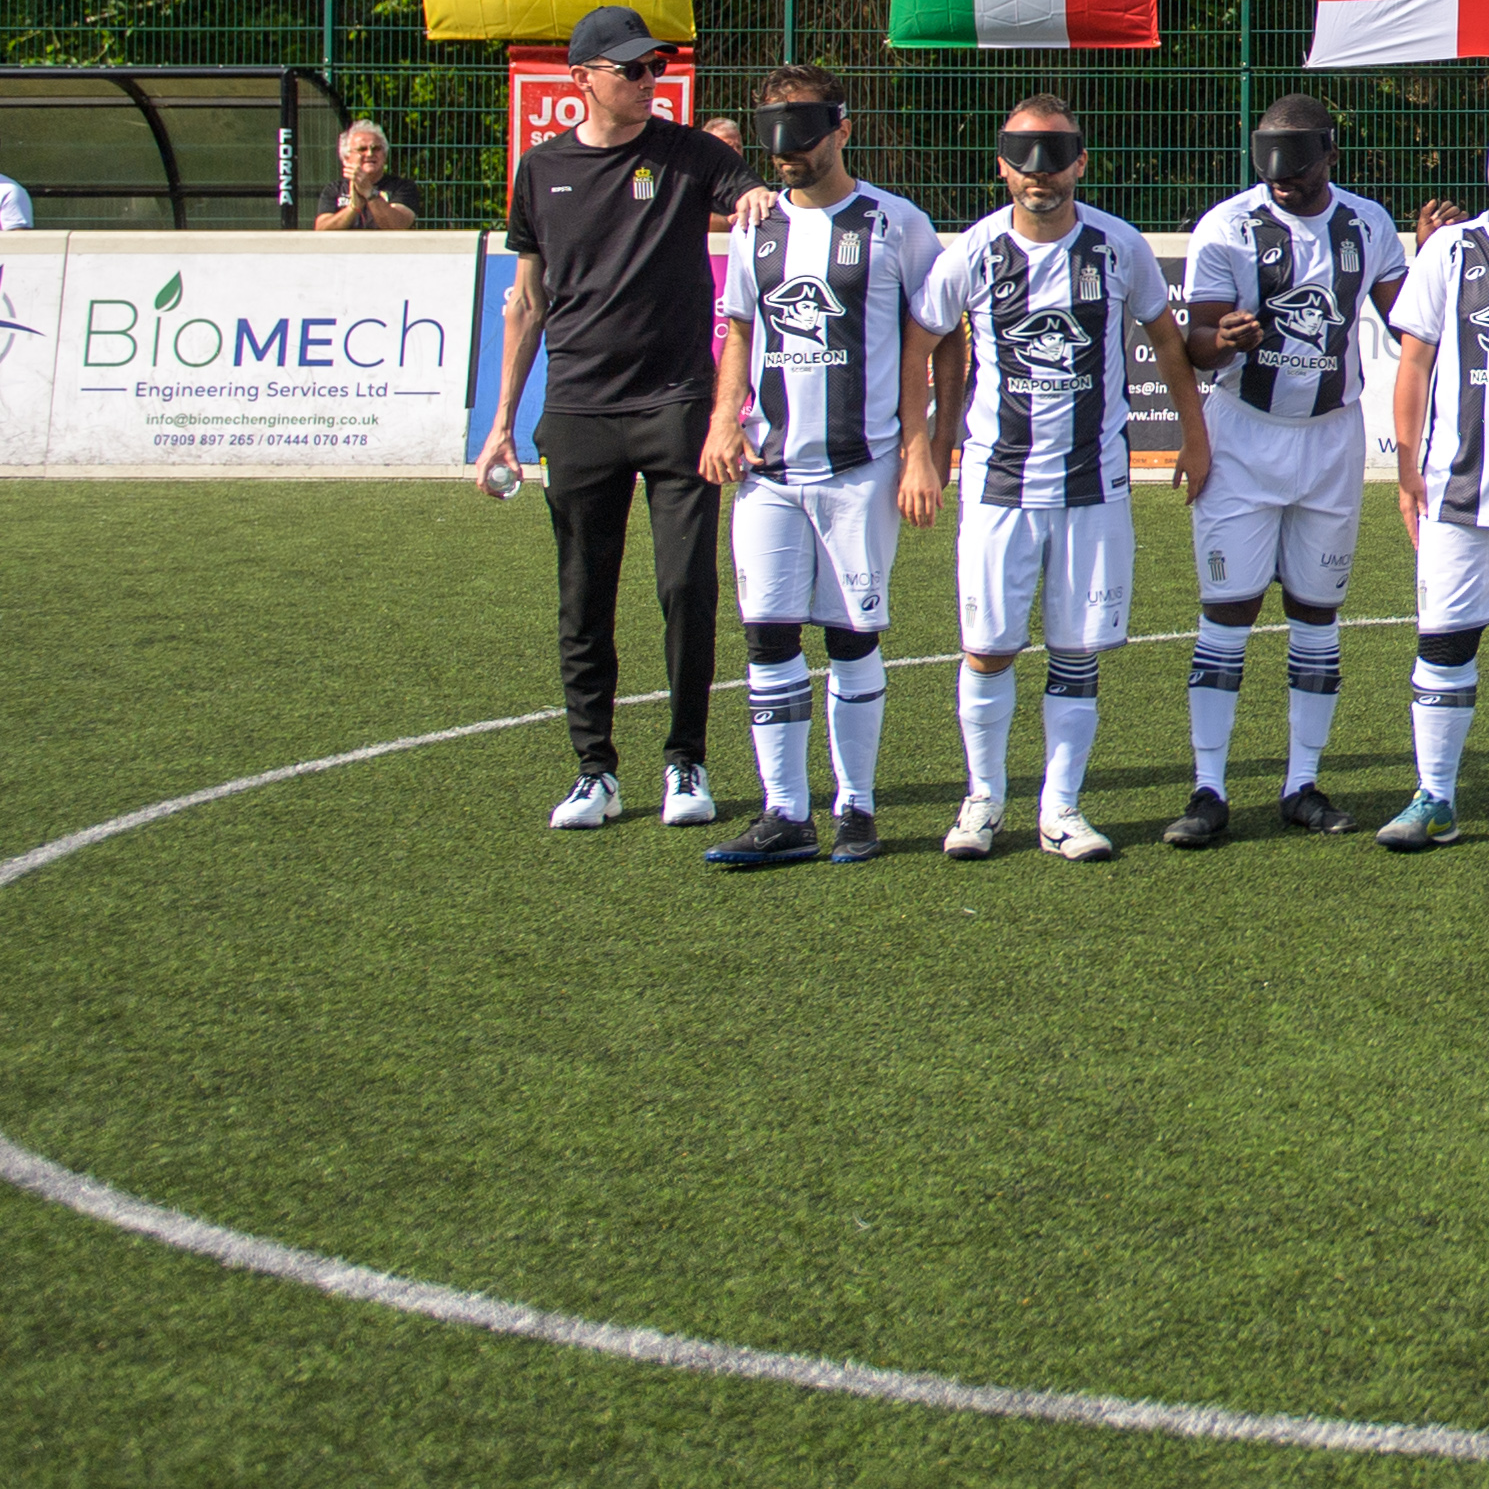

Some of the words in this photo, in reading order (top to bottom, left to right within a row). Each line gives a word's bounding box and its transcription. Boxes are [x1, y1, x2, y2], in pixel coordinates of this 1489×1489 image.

[278, 128, 293, 206] FORZA
[765, 349, 848, 368] NAPOLEON
[1258, 349, 1338, 371] NAPOLEON
[135, 381, 259, 402] Engineering
[266, 381, 349, 398] Services
[356, 381, 388, 397] Ltd
[1007, 375, 1093, 394] NAPOLEON
[145, 413, 379, 428] info@biomechengineering.co.uk
[153, 434, 196, 447] 07909
[200, 434, 224, 447] 897
[229, 434, 255, 447] 265
[267, 434, 309, 447] 07444
[313, 434, 338, 447] 070
[343, 434, 368, 447] 478
